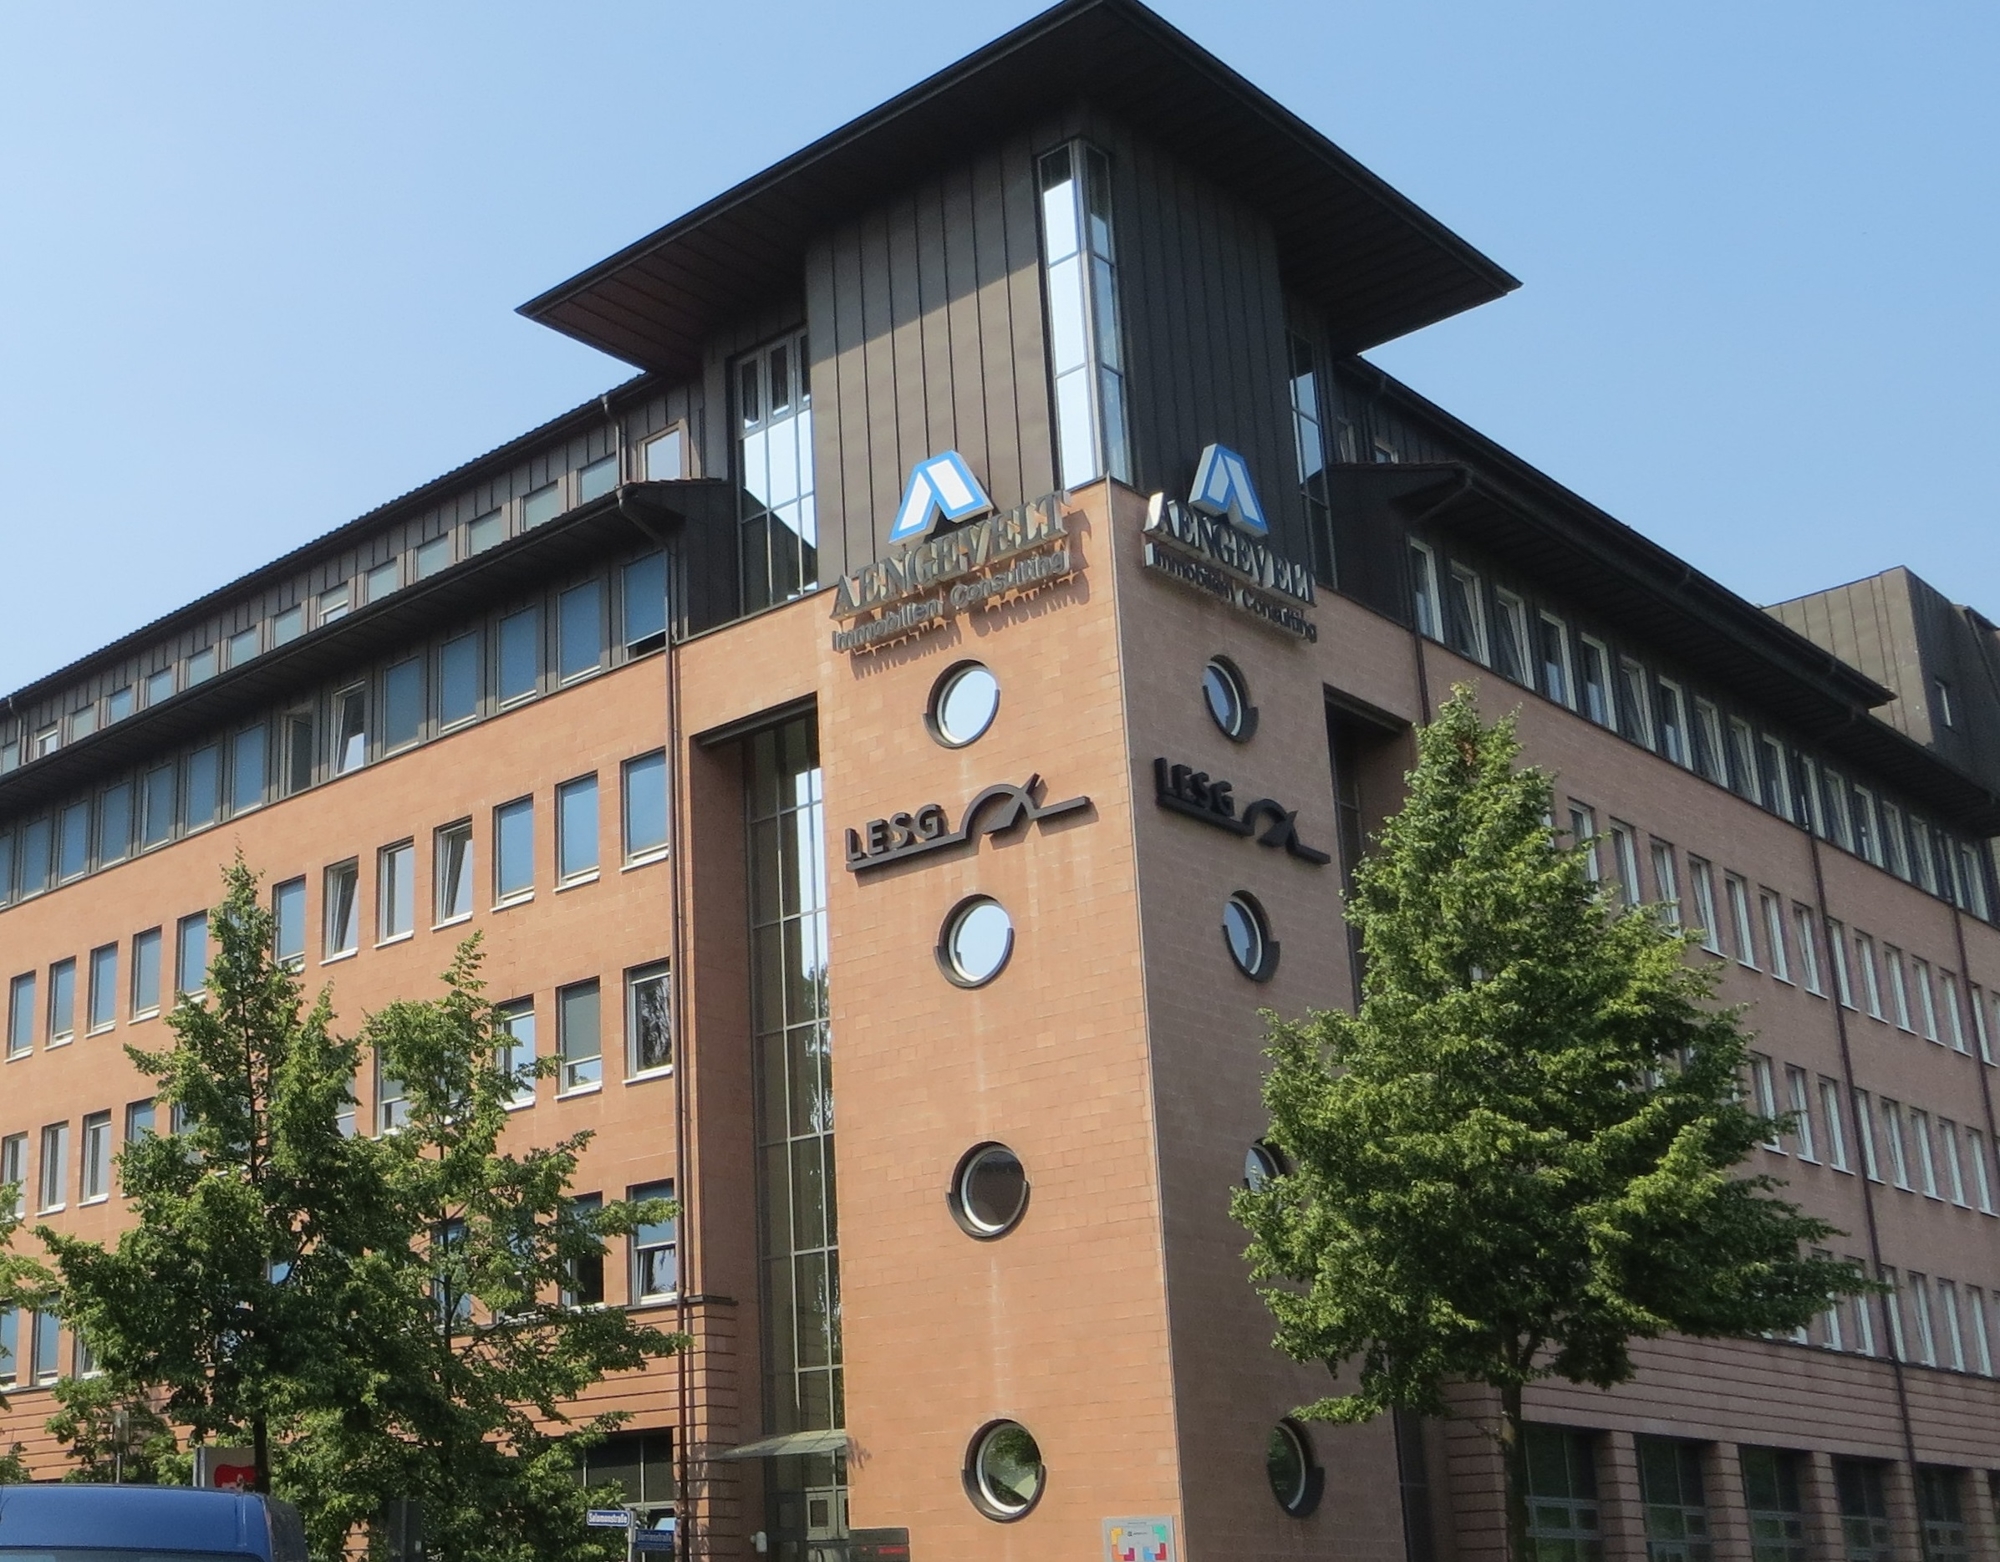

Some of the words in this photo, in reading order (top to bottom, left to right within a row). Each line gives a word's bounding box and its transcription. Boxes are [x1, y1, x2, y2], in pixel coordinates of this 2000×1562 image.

[829, 491, 1071, 620] AENGEVELT
[1143, 492, 1317, 608] AENGEVELT
[832, 599, 944, 653] Immobilien
[950, 550, 1069, 609] Consulting
[1154, 757, 1234, 818] LESG
[845, 803, 942, 862] LESG
[588, 1512, 628, 1524] Salomonstraße
